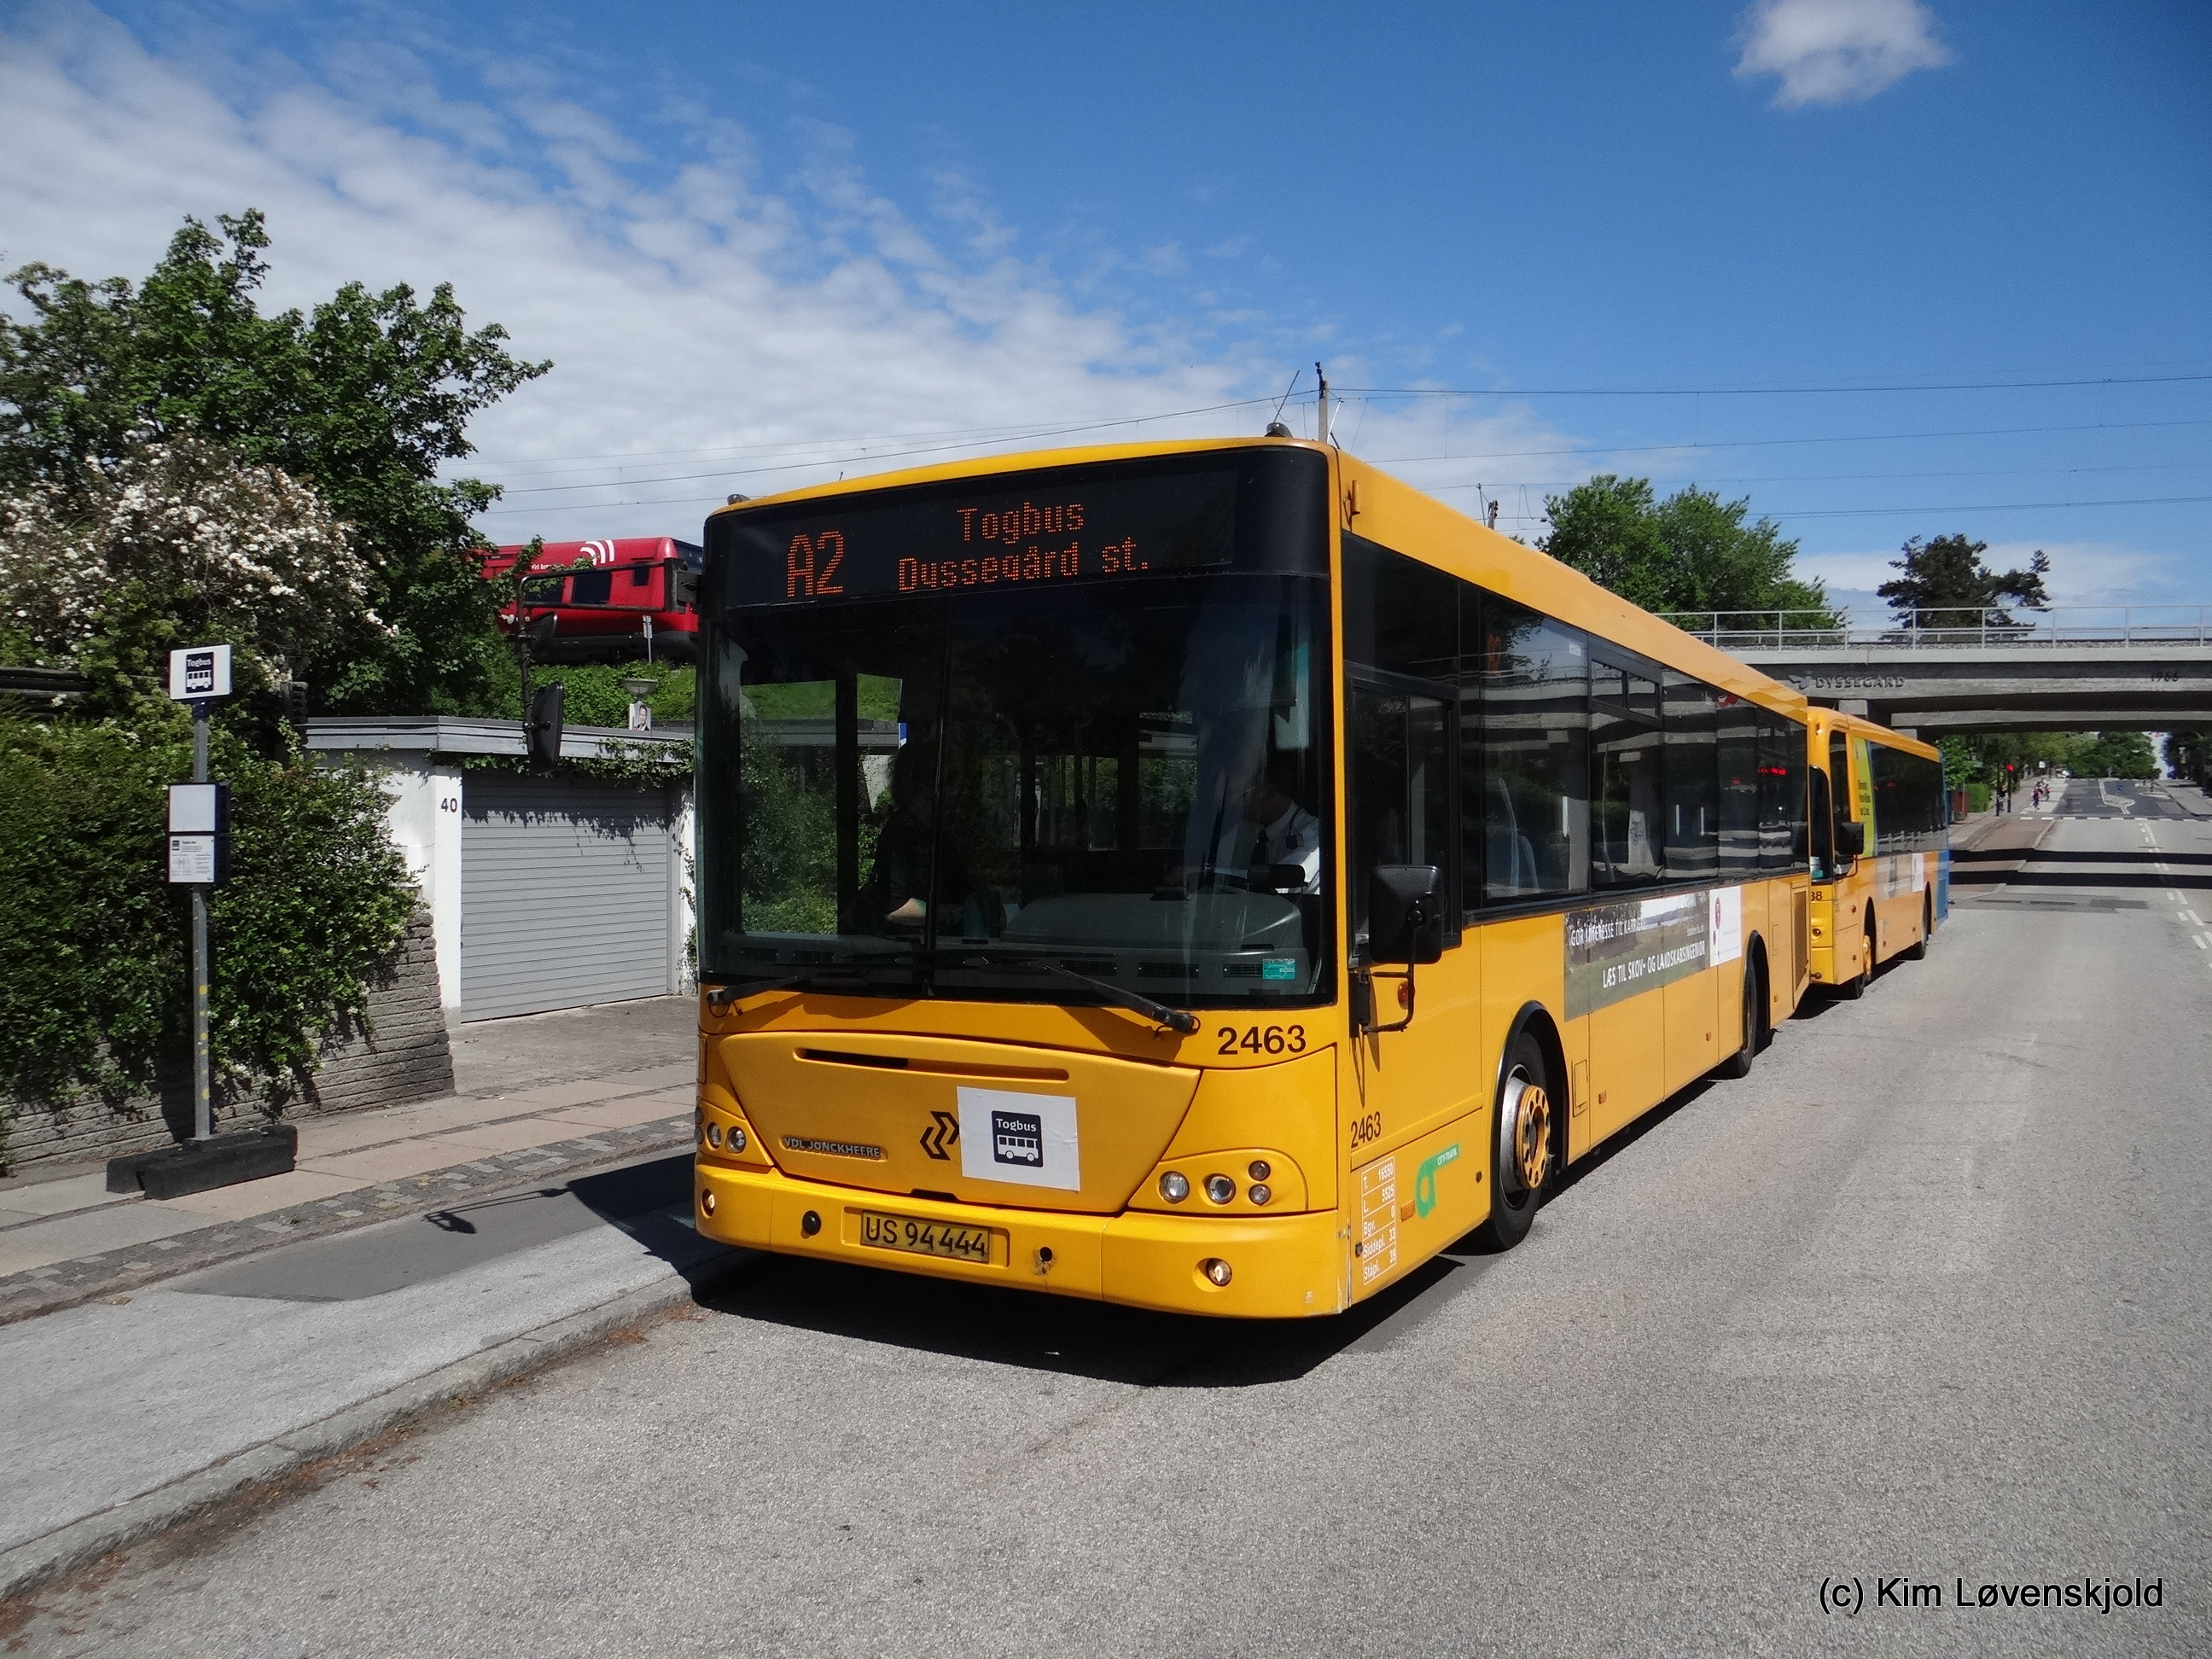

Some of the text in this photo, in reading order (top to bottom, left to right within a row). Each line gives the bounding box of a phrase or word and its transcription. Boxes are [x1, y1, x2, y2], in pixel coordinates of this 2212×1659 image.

[957, 502, 1085, 544] Togbus
[786, 530, 845, 597] A2
[1100, 536, 1150, 573] st.
[186, 657, 212, 669] Togbus
[440, 797, 458, 814] 40
[1603, 967, 1615, 988] LÆS
[1618, 964, 1627, 983] TIL
[1647, 954, 1656, 974] OG
[1217, 1024, 1307, 1056] 2463
[995, 1118, 1037, 1132] Togbus
[1350, 1110, 1382, 1149] 2463
[783, 1137, 881, 1157] VDL JONCKHEERE
[1363, 1176, 1369, 1190] T.
[865, 1216, 898, 1244] US
